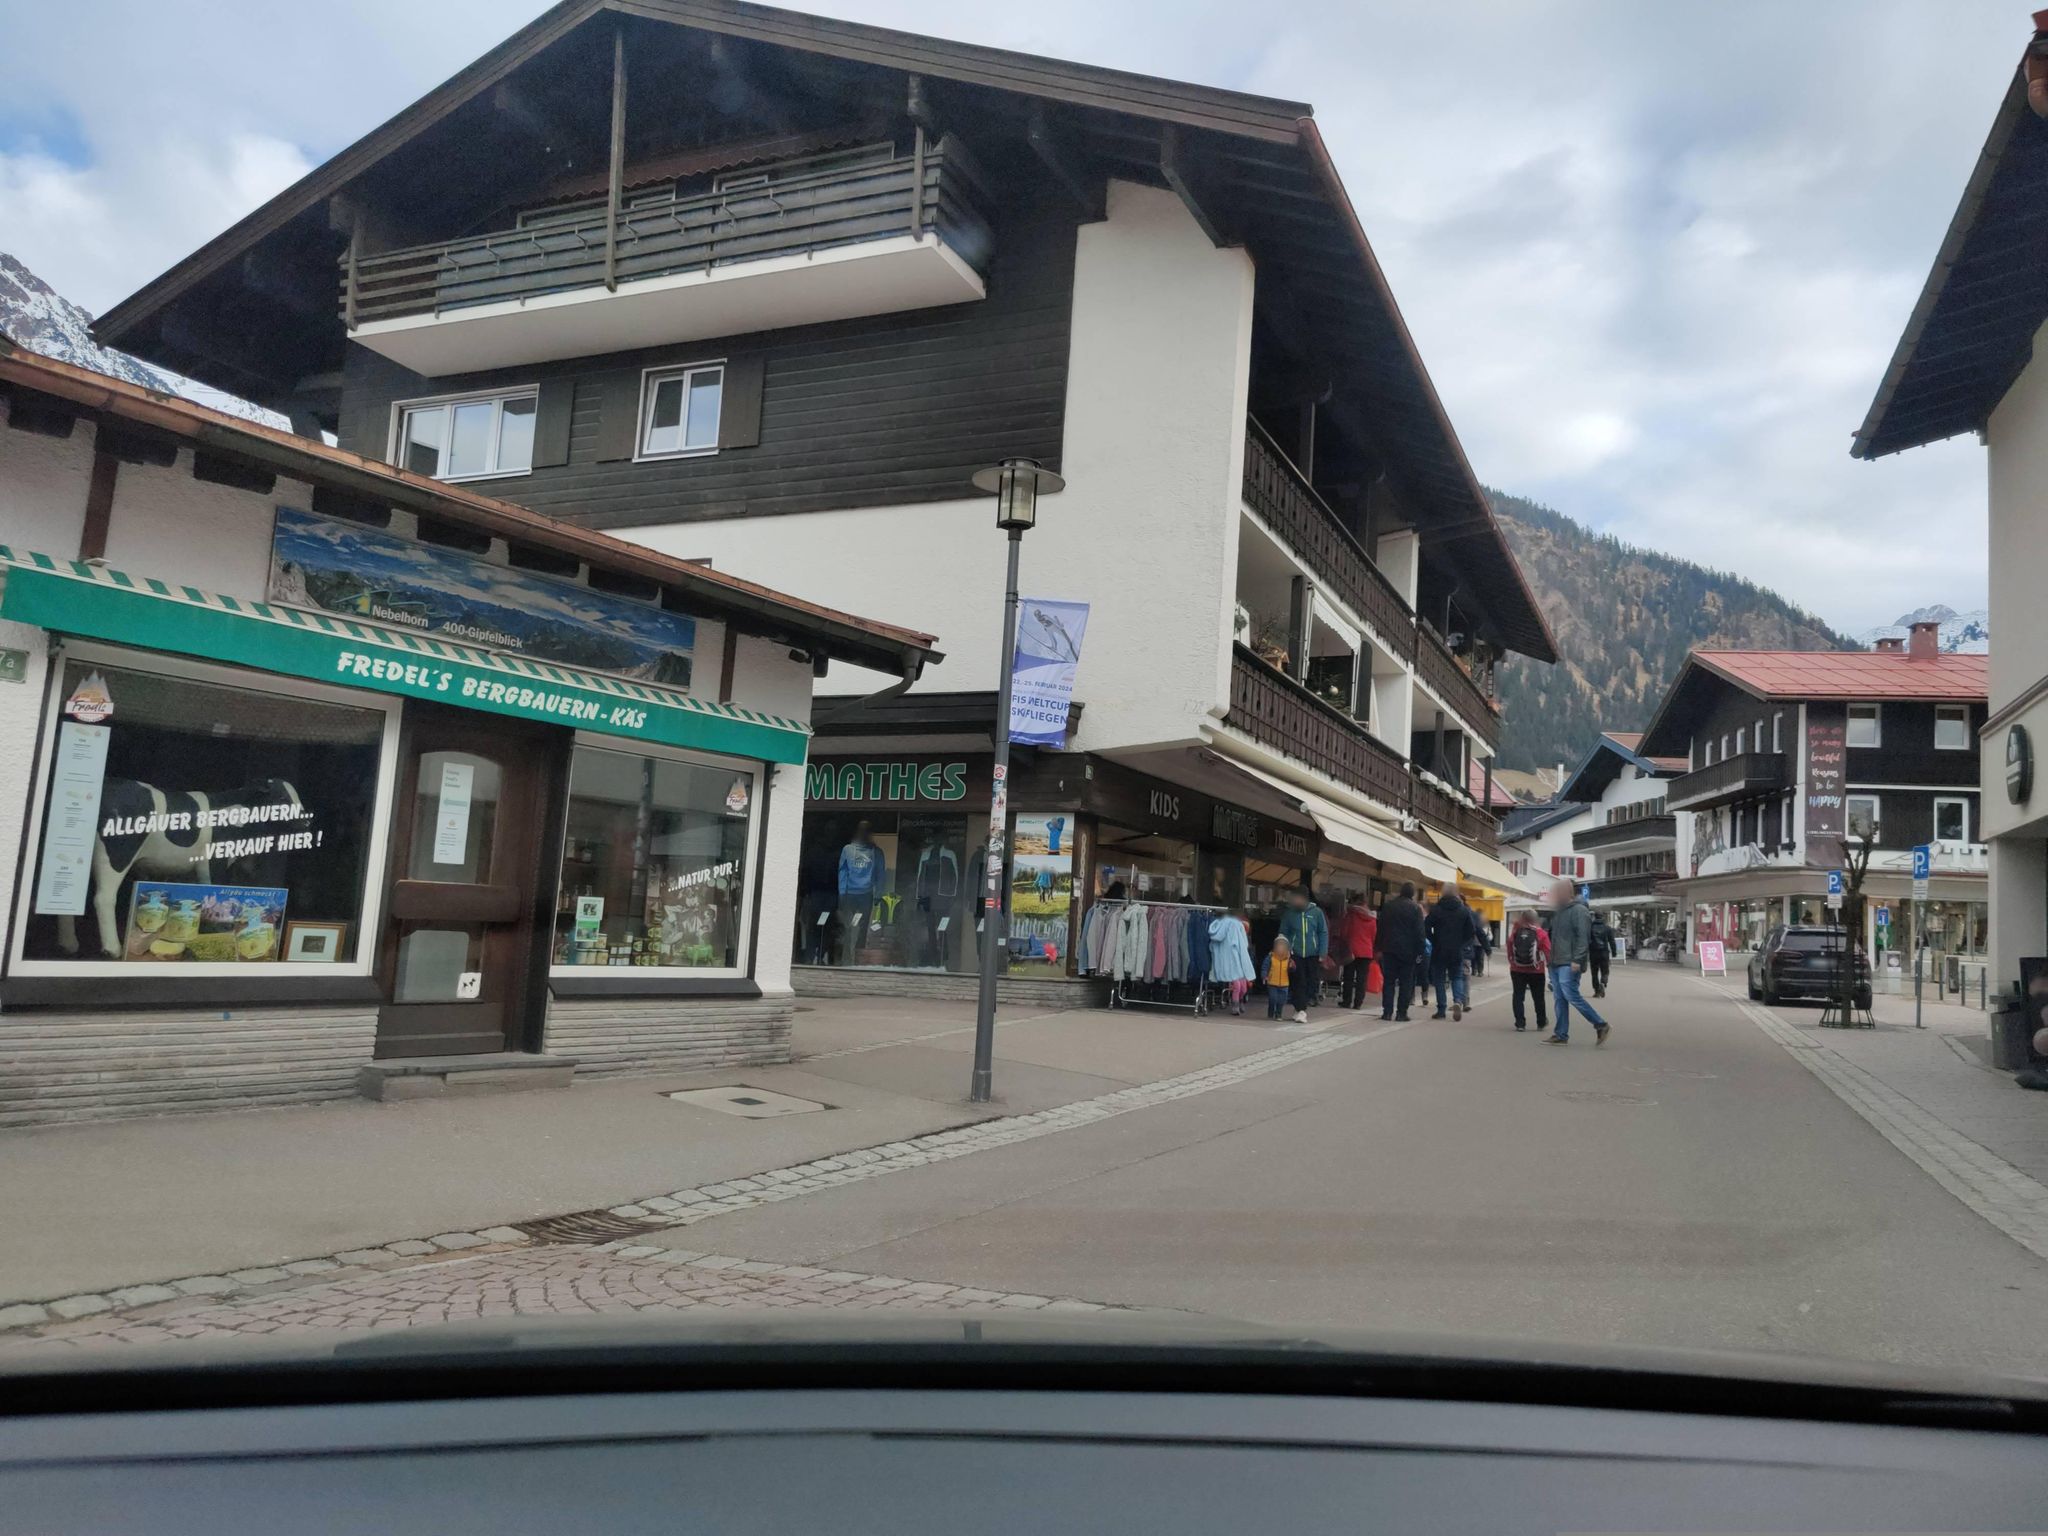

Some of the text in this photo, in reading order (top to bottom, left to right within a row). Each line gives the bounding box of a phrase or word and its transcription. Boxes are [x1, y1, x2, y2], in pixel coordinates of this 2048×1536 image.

[372, 605, 523, 648] Nebelhorn 400-Gipfelblick
[337, 652, 453, 691] FREDEL'S
[1012, 694, 1027, 704] FIS
[804, 763, 967, 801] MATHES
[1150, 789, 1180, 821] KIDS
[102, 811, 192, 838] ALLGÄUER
[196, 803, 314, 829] BERGBAUERN...
[189, 836, 275, 862] ...VERKAUF
[278, 832, 313, 852] HIER
[1274, 829, 1308, 856] TRACHTEN
[713, 862, 733, 880] PUR
[1914, 851, 1925, 874] P
[1829, 874, 1839, 891] P
